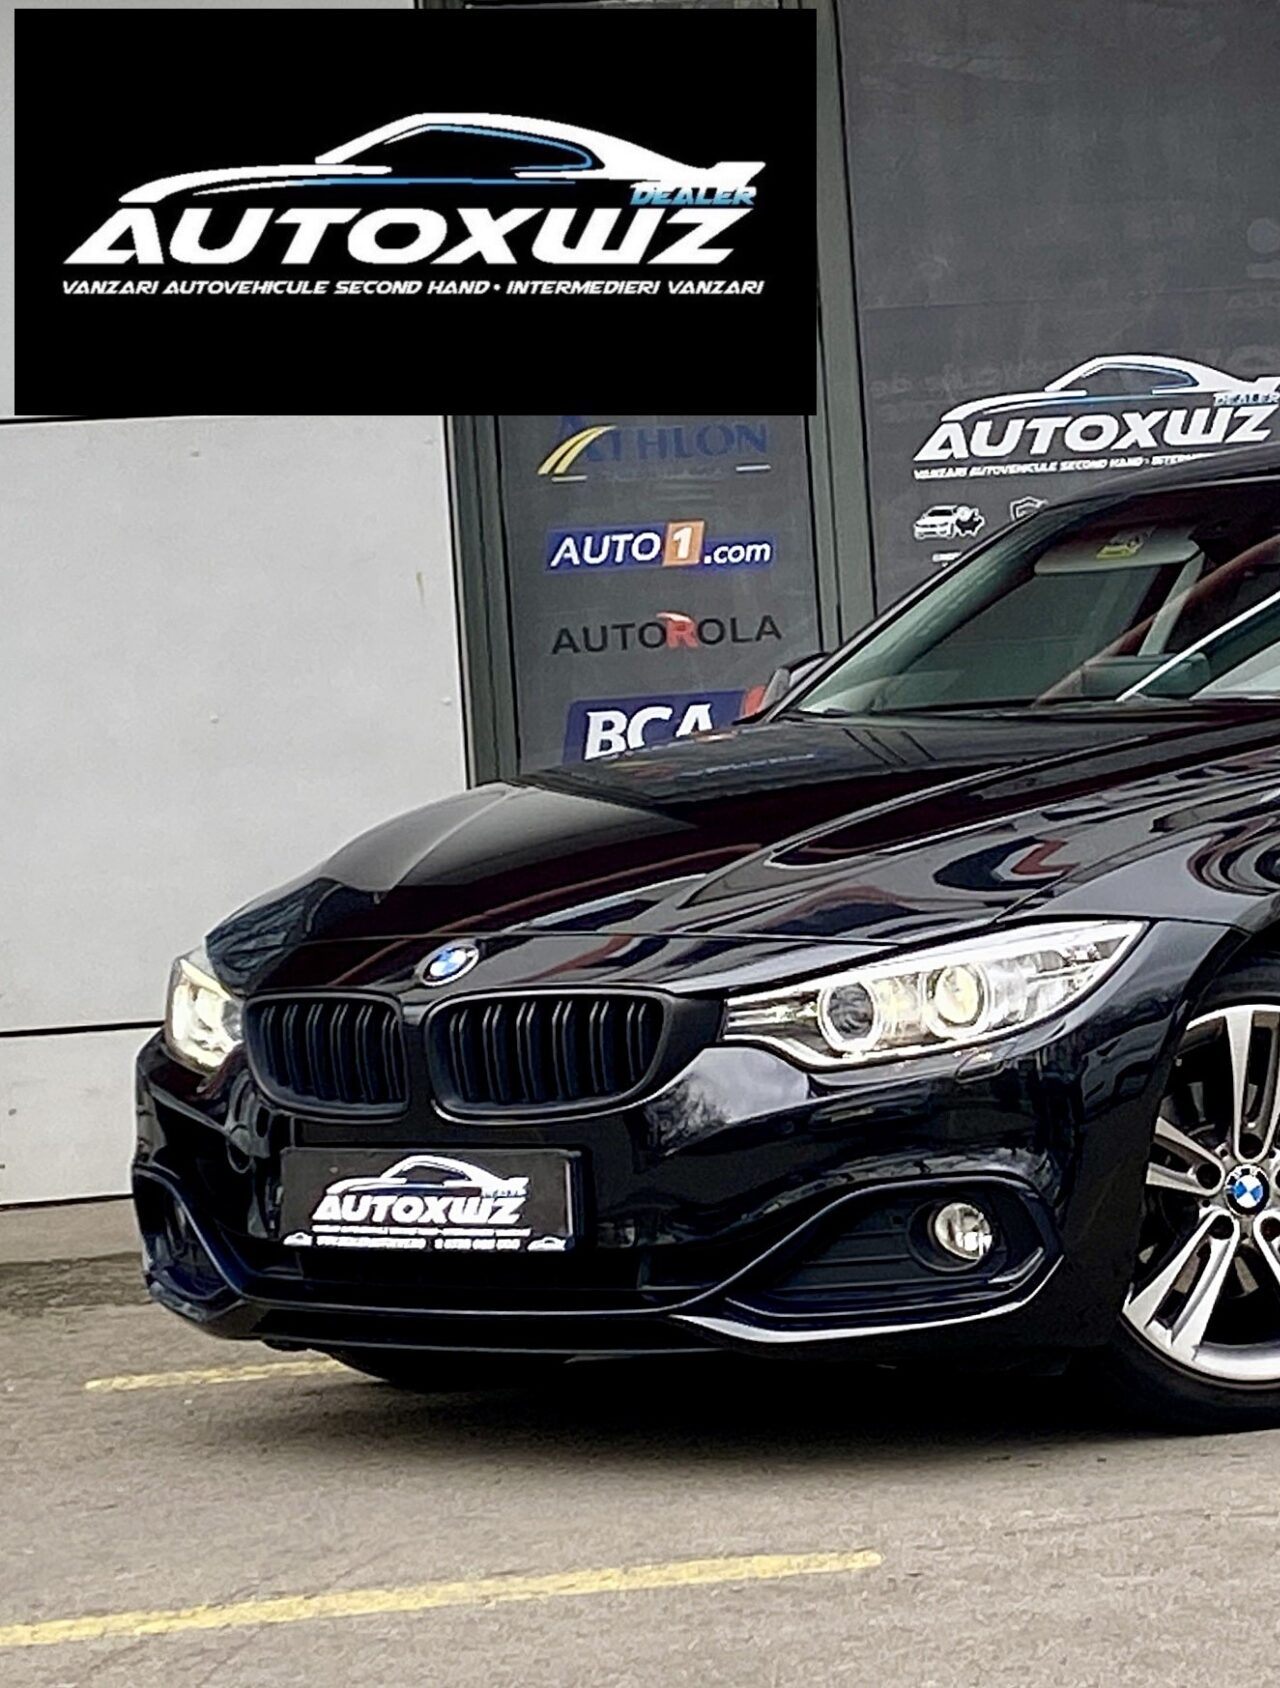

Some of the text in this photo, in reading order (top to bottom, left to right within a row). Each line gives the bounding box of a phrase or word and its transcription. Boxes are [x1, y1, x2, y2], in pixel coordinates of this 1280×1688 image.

[912, 403, 1280, 462] AUTOXWZ
[550, 526, 772, 568] AUTO1.com
[551, 610, 783, 655] AUTOROLA
[584, 703, 714, 761] BCA
[311, 1195, 528, 1225] AUTOXWZ
